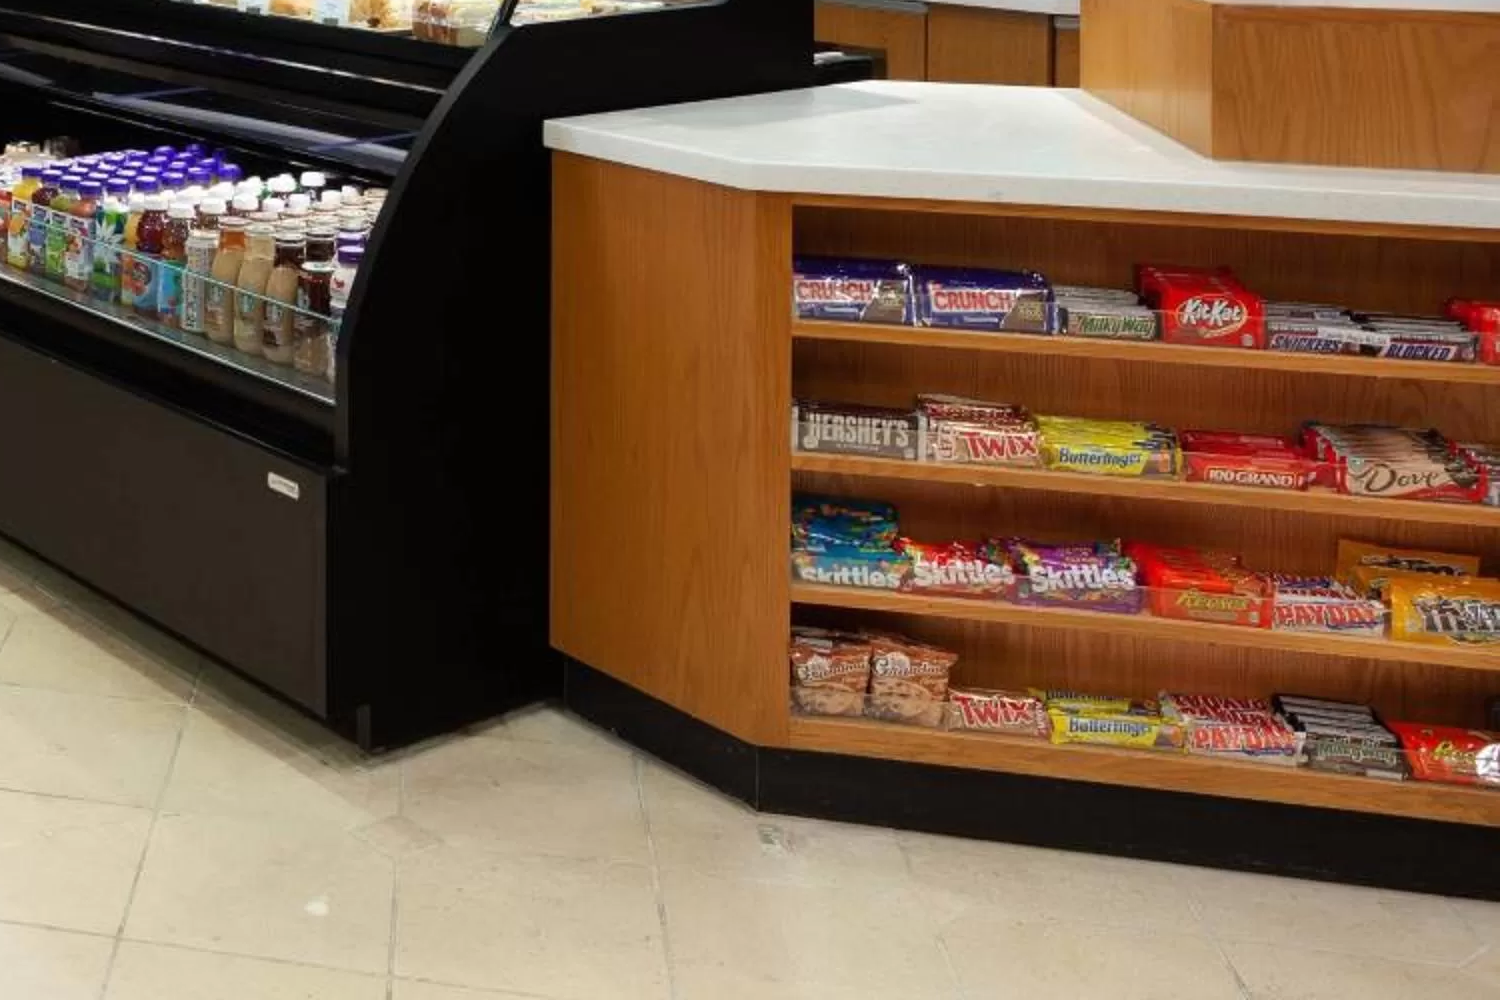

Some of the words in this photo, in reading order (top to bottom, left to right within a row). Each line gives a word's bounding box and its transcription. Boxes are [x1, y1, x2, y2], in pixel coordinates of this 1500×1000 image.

[934, 290, 1013, 311] CRUNCH
[807, 413, 909, 445] HERSHEY'S
[1235, 471, 1293, 487] GRAND
